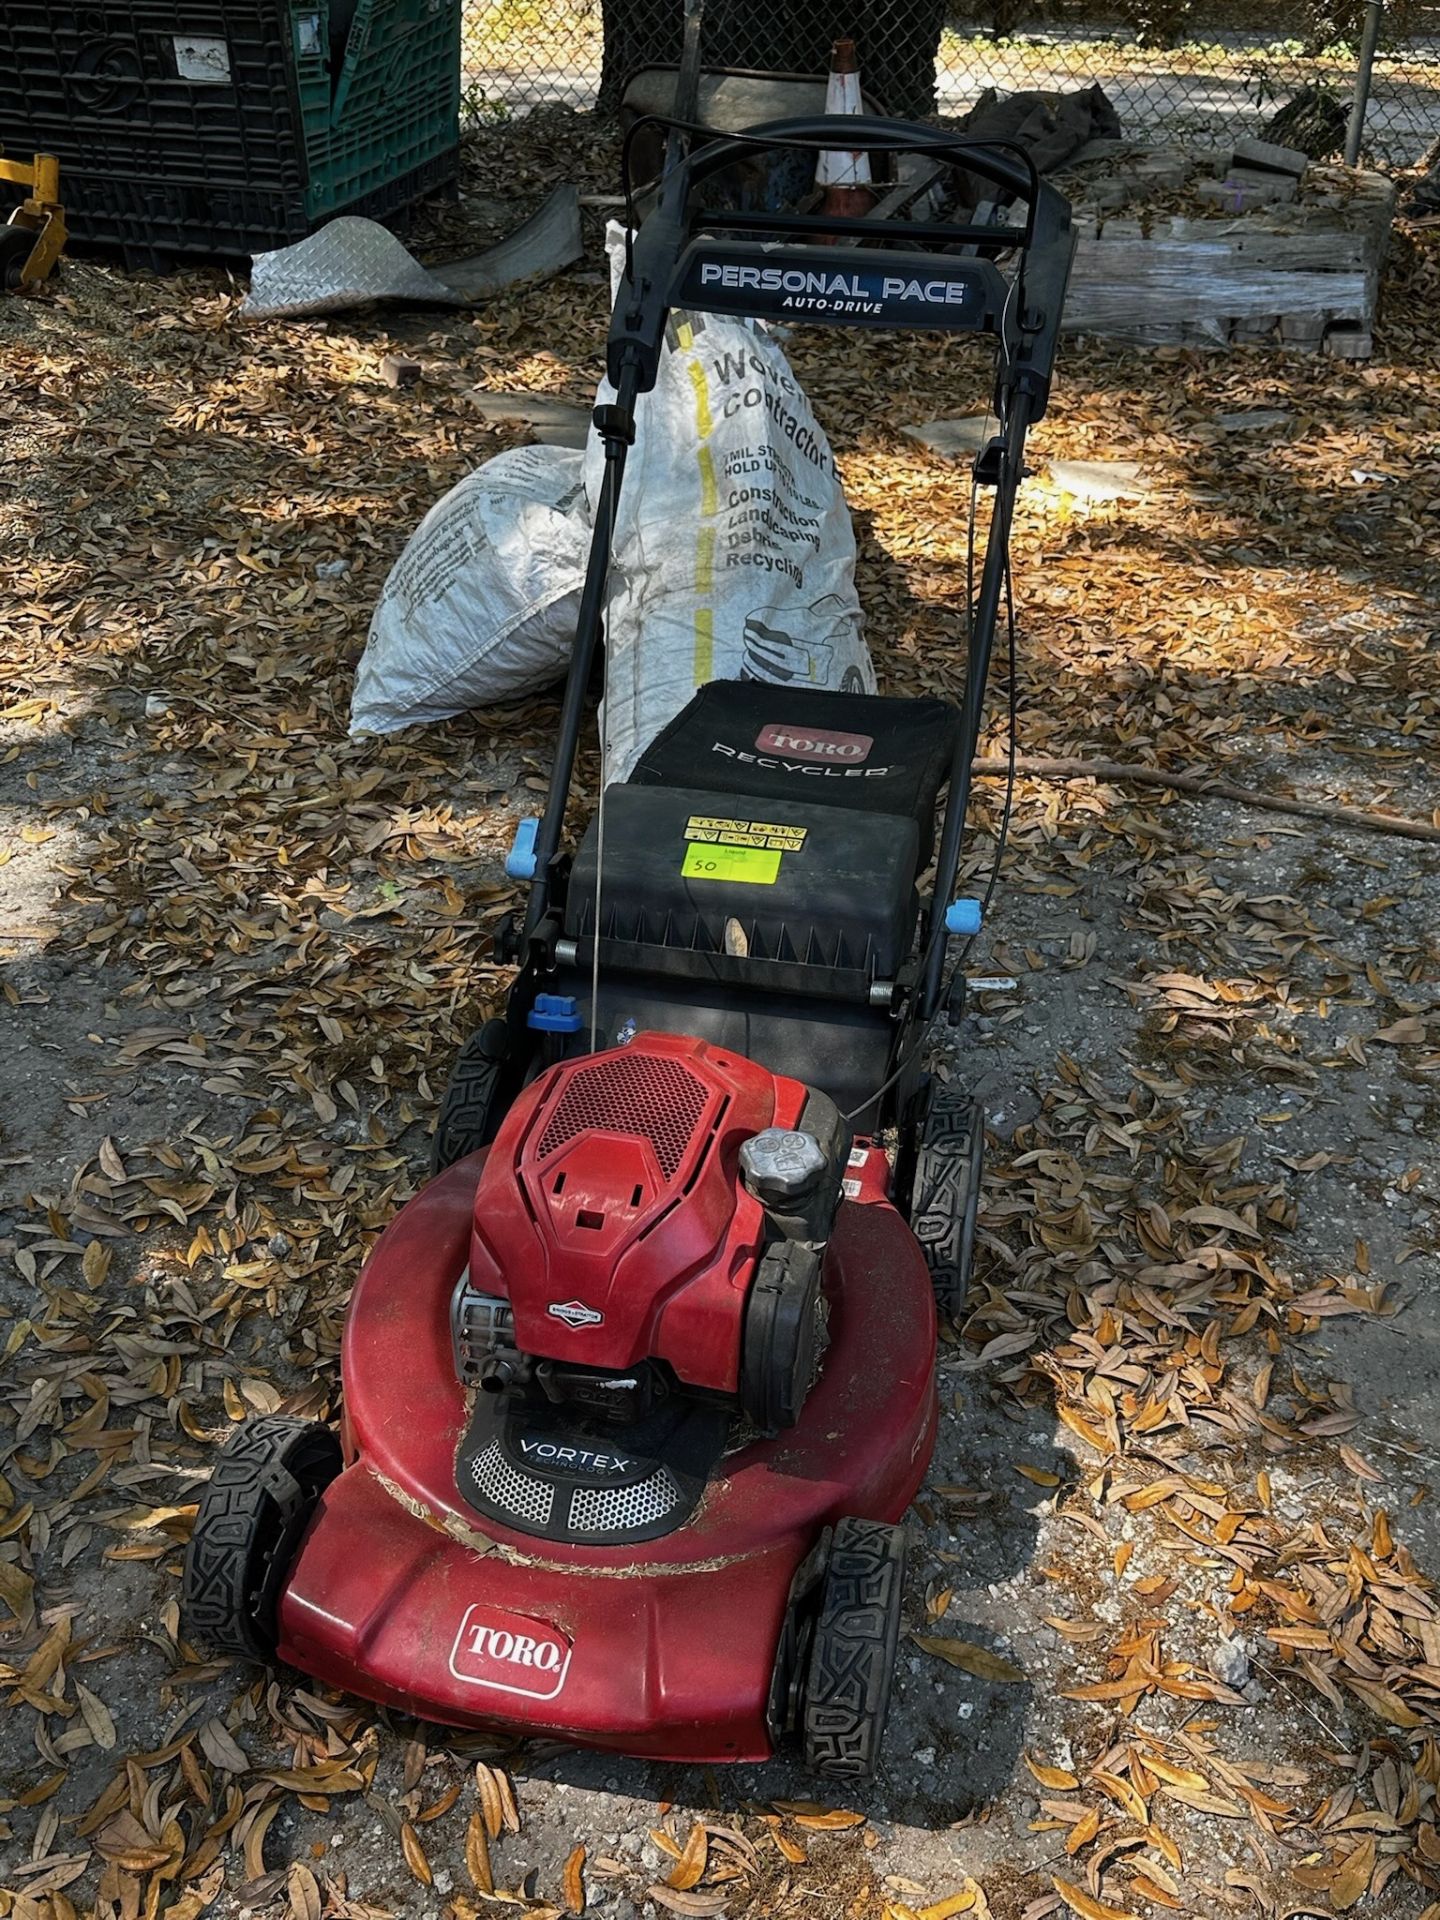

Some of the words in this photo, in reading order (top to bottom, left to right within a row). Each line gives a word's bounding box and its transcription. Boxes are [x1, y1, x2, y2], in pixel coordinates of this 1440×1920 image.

[701, 263, 869, 298] PERSONAL
[882, 277, 965, 305] PACE
[782, 296, 884, 315] AUTO-DRIVE
[723, 387, 828, 471] Contractor
[725, 460, 760, 479] HOLD
[729, 487, 820, 528] Construction
[726, 552, 803, 590] Recycling
[712, 742, 888, 777] RECYCLER
[769, 733, 862, 756] TORO
[694, 860, 717, 872] 50
[520, 1439, 630, 1473] VORTEX
[528, 1454, 615, 1476] TECHNOLOGY
[468, 1624, 560, 1671] TORO
